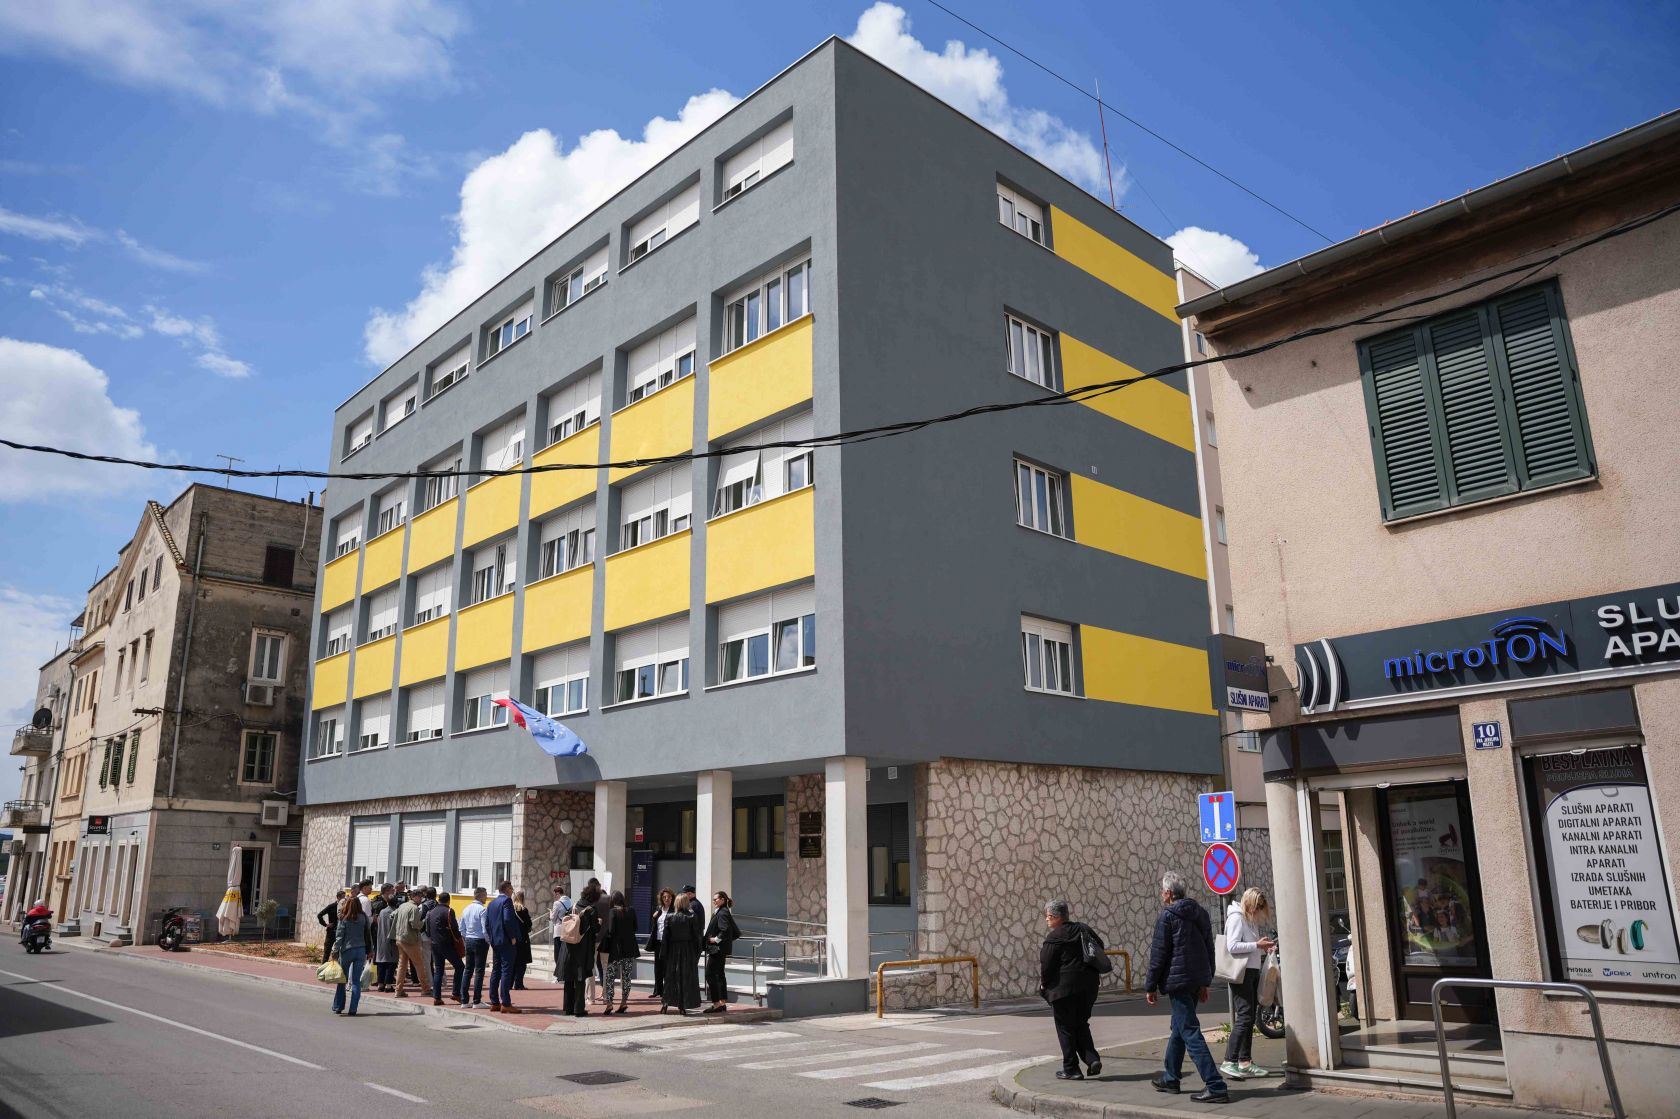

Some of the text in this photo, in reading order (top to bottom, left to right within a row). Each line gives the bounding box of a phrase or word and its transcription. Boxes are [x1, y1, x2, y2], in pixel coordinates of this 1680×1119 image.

[1597, 595, 1680, 628] SLU
[1604, 628, 1680, 659] APA
[1383, 627, 1568, 679] microTON
[1477, 724, 1496, 738] 10
[1561, 802, 1634, 815] SLUŠNI APARATI
[1558, 816, 1642, 829] DIGITALNI APARATI
[1562, 830, 1643, 842] KANALNI APARATI
[1569, 844, 1639, 855] INTRA KANALNI
[1586, 858, 1626, 869] APARATI
[1571, 870, 1647, 882] IZRADA SLUŠNIH
[1588, 885, 1633, 896] UMETAKA
[1570, 899, 1613, 910] BATERIJE
[1620, 900, 1657, 911] PRIBOR
[1642, 971, 1677, 980] unitron
